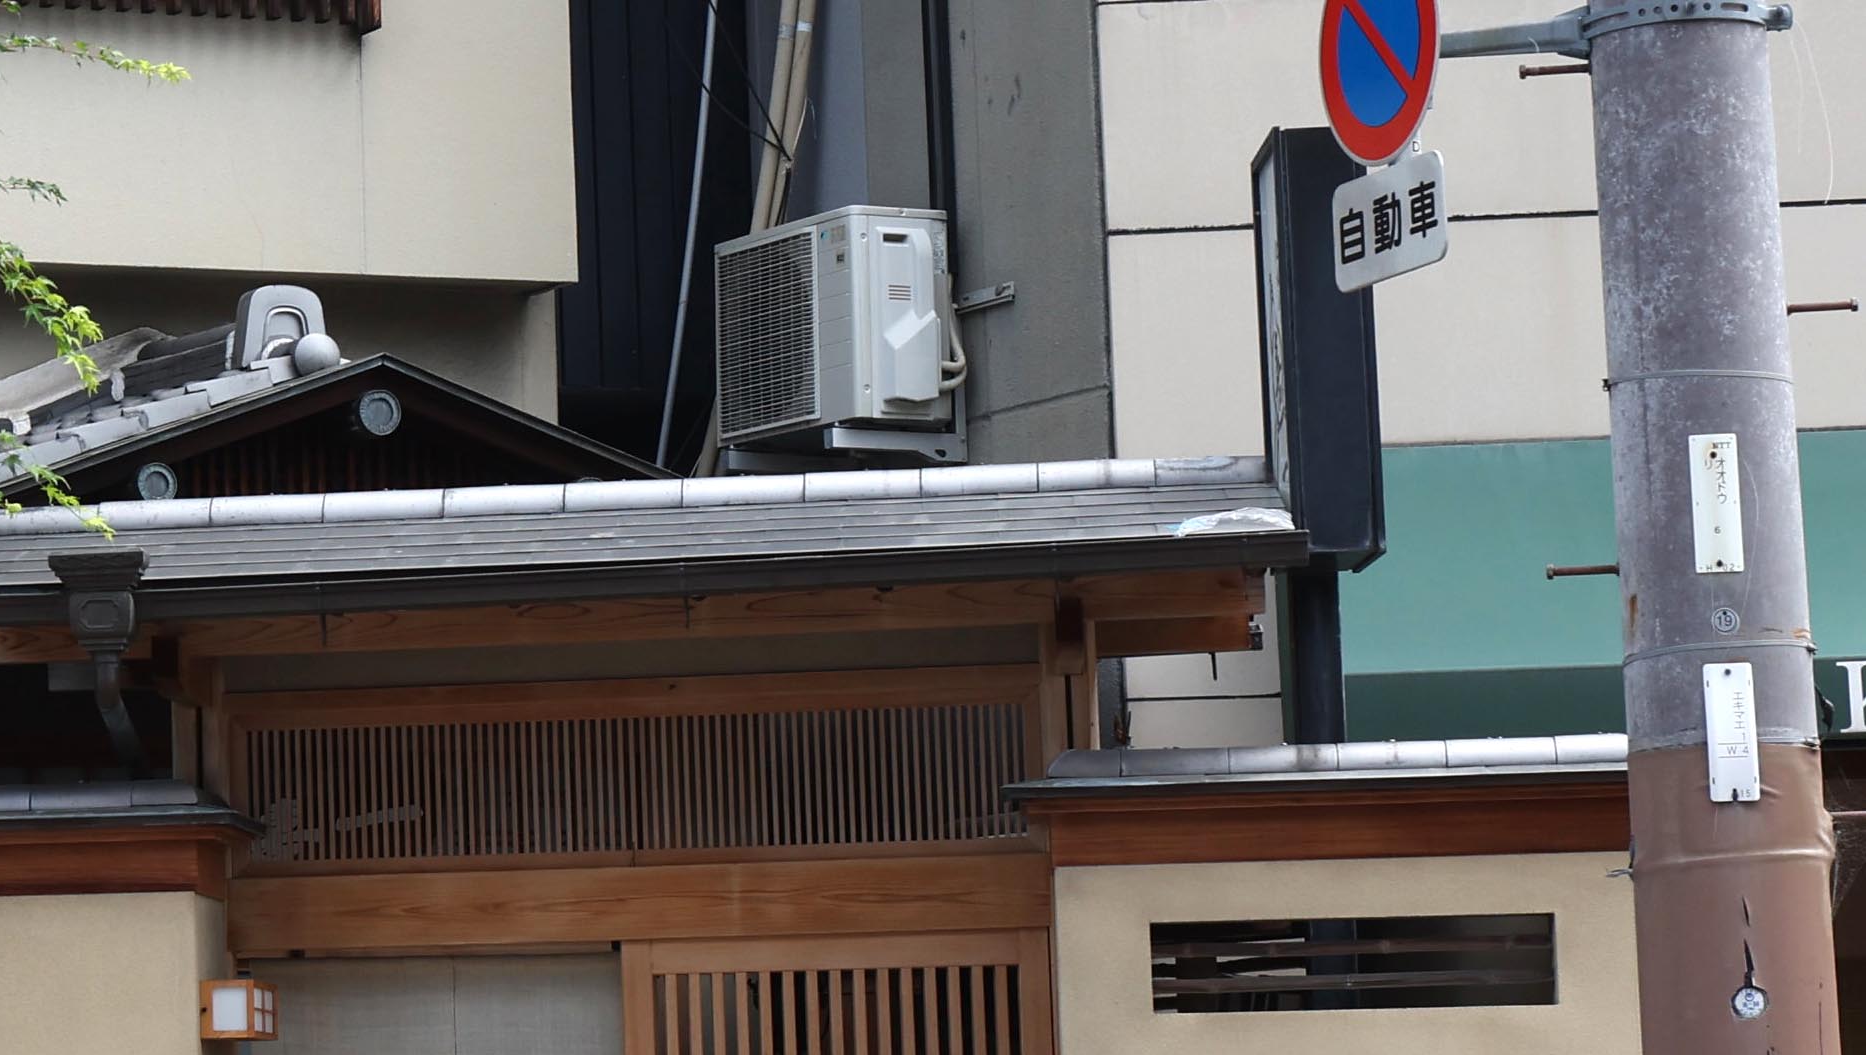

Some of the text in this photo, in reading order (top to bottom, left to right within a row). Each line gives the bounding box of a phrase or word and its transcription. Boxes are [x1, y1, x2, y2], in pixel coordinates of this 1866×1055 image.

[1339, 181, 1438, 265] 自動車
[1714, 526, 1721, 534] 6
[1716, 615, 1733, 627] 19
